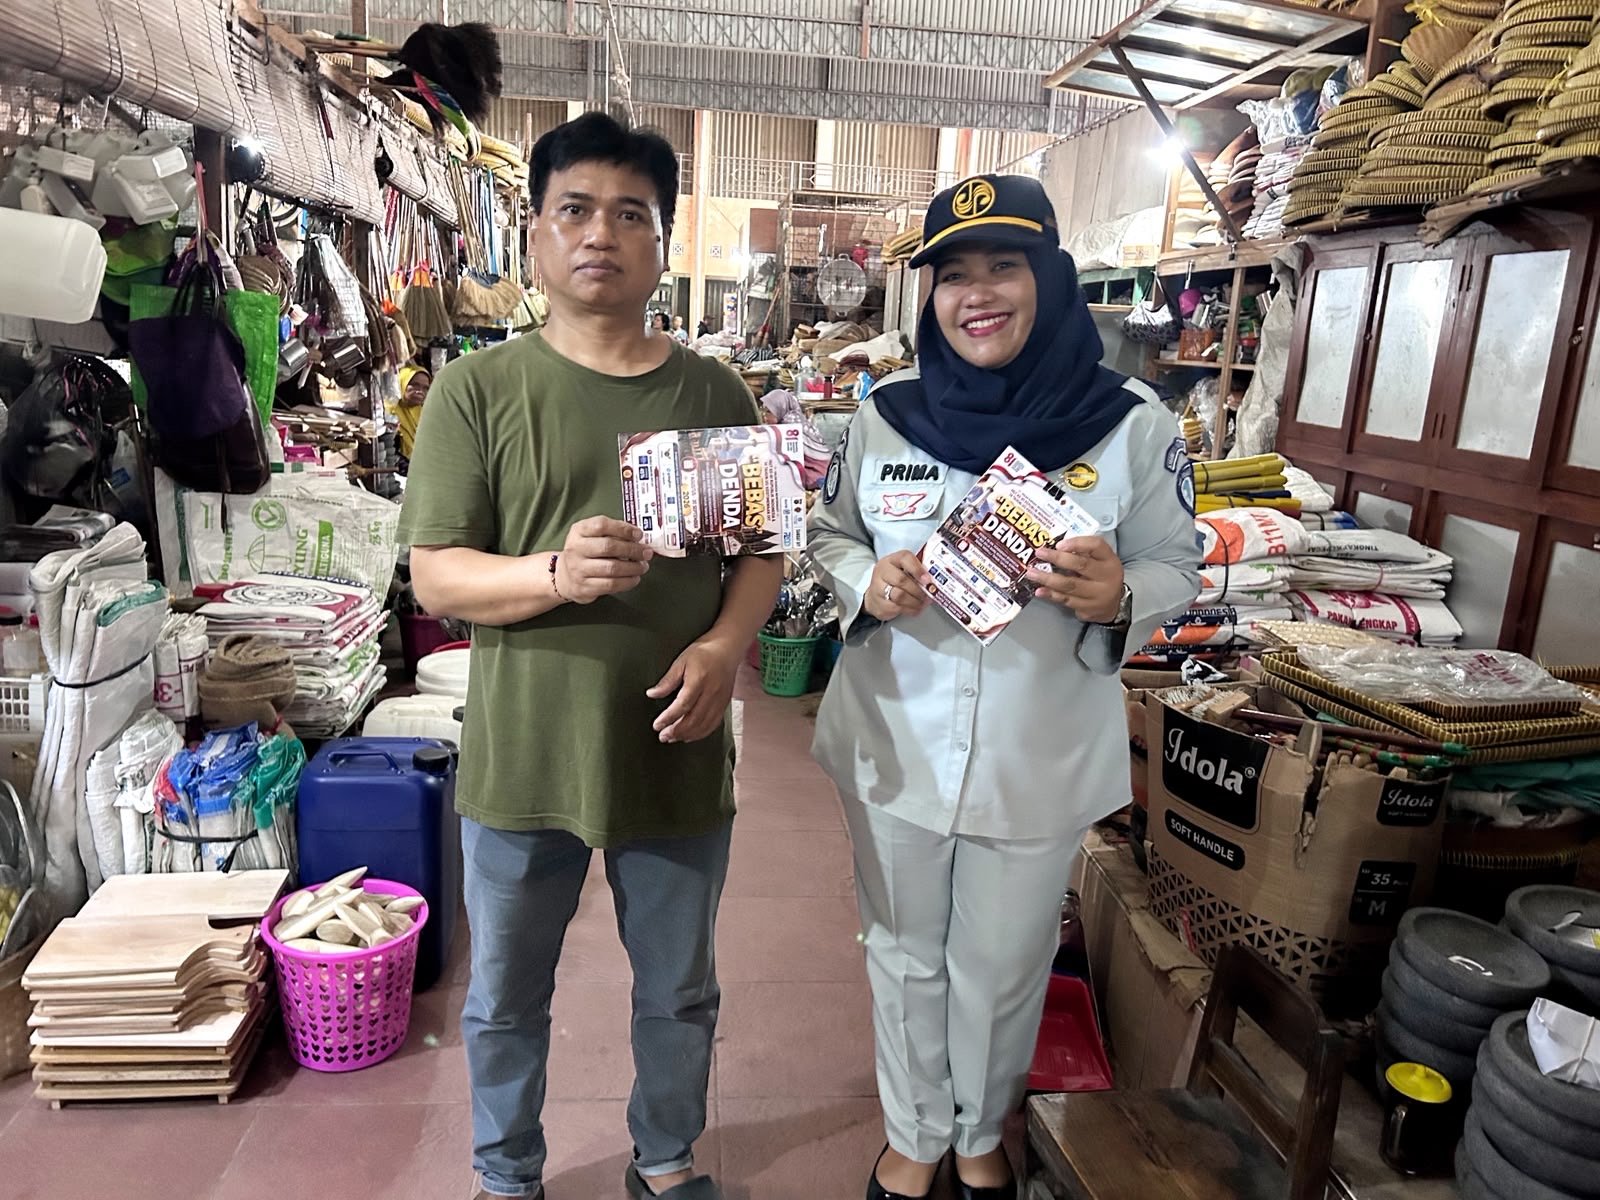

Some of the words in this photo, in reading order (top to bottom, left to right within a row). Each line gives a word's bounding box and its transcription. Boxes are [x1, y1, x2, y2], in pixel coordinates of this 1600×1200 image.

[785, 428, 799, 441] 81
[1004, 452, 1016, 467] 81
[880, 463, 939, 482] PRIMA
[719, 463, 741, 529] DENDA
[982, 514, 1034, 566] DENDA
[1360, 617, 1398, 630] ENGKAP
[1170, 817, 1192, 840] SOFT
[1193, 831, 1235, 862] HANDLE
[1371, 873, 1392, 886] 35
[1368, 899, 1388, 916] M
